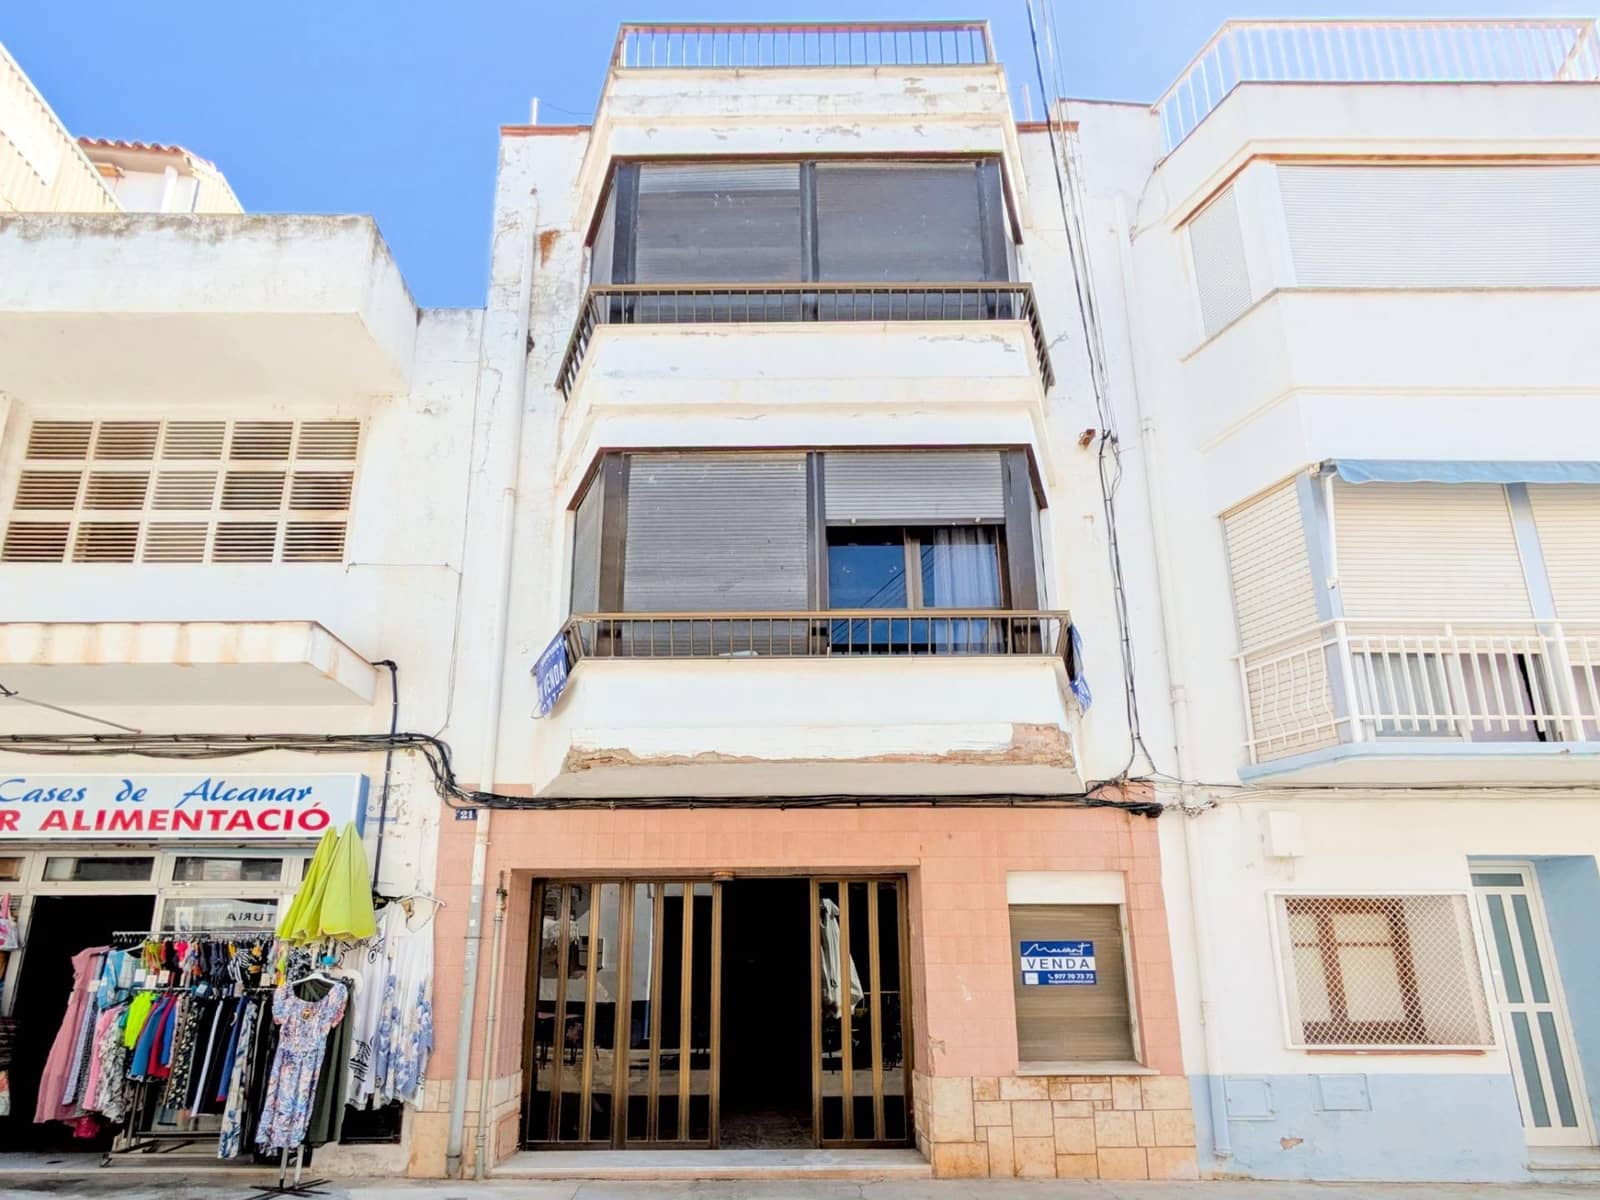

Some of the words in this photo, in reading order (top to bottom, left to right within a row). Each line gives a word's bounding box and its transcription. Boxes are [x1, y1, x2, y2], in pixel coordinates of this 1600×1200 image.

[0, 778, 87, 802] Cases
[115, 779, 148, 802] de
[174, 778, 313, 809] Alcanar
[39, 802, 331, 832] ALIMENTACIÓ
[1027, 958, 1090, 969] VENDA
